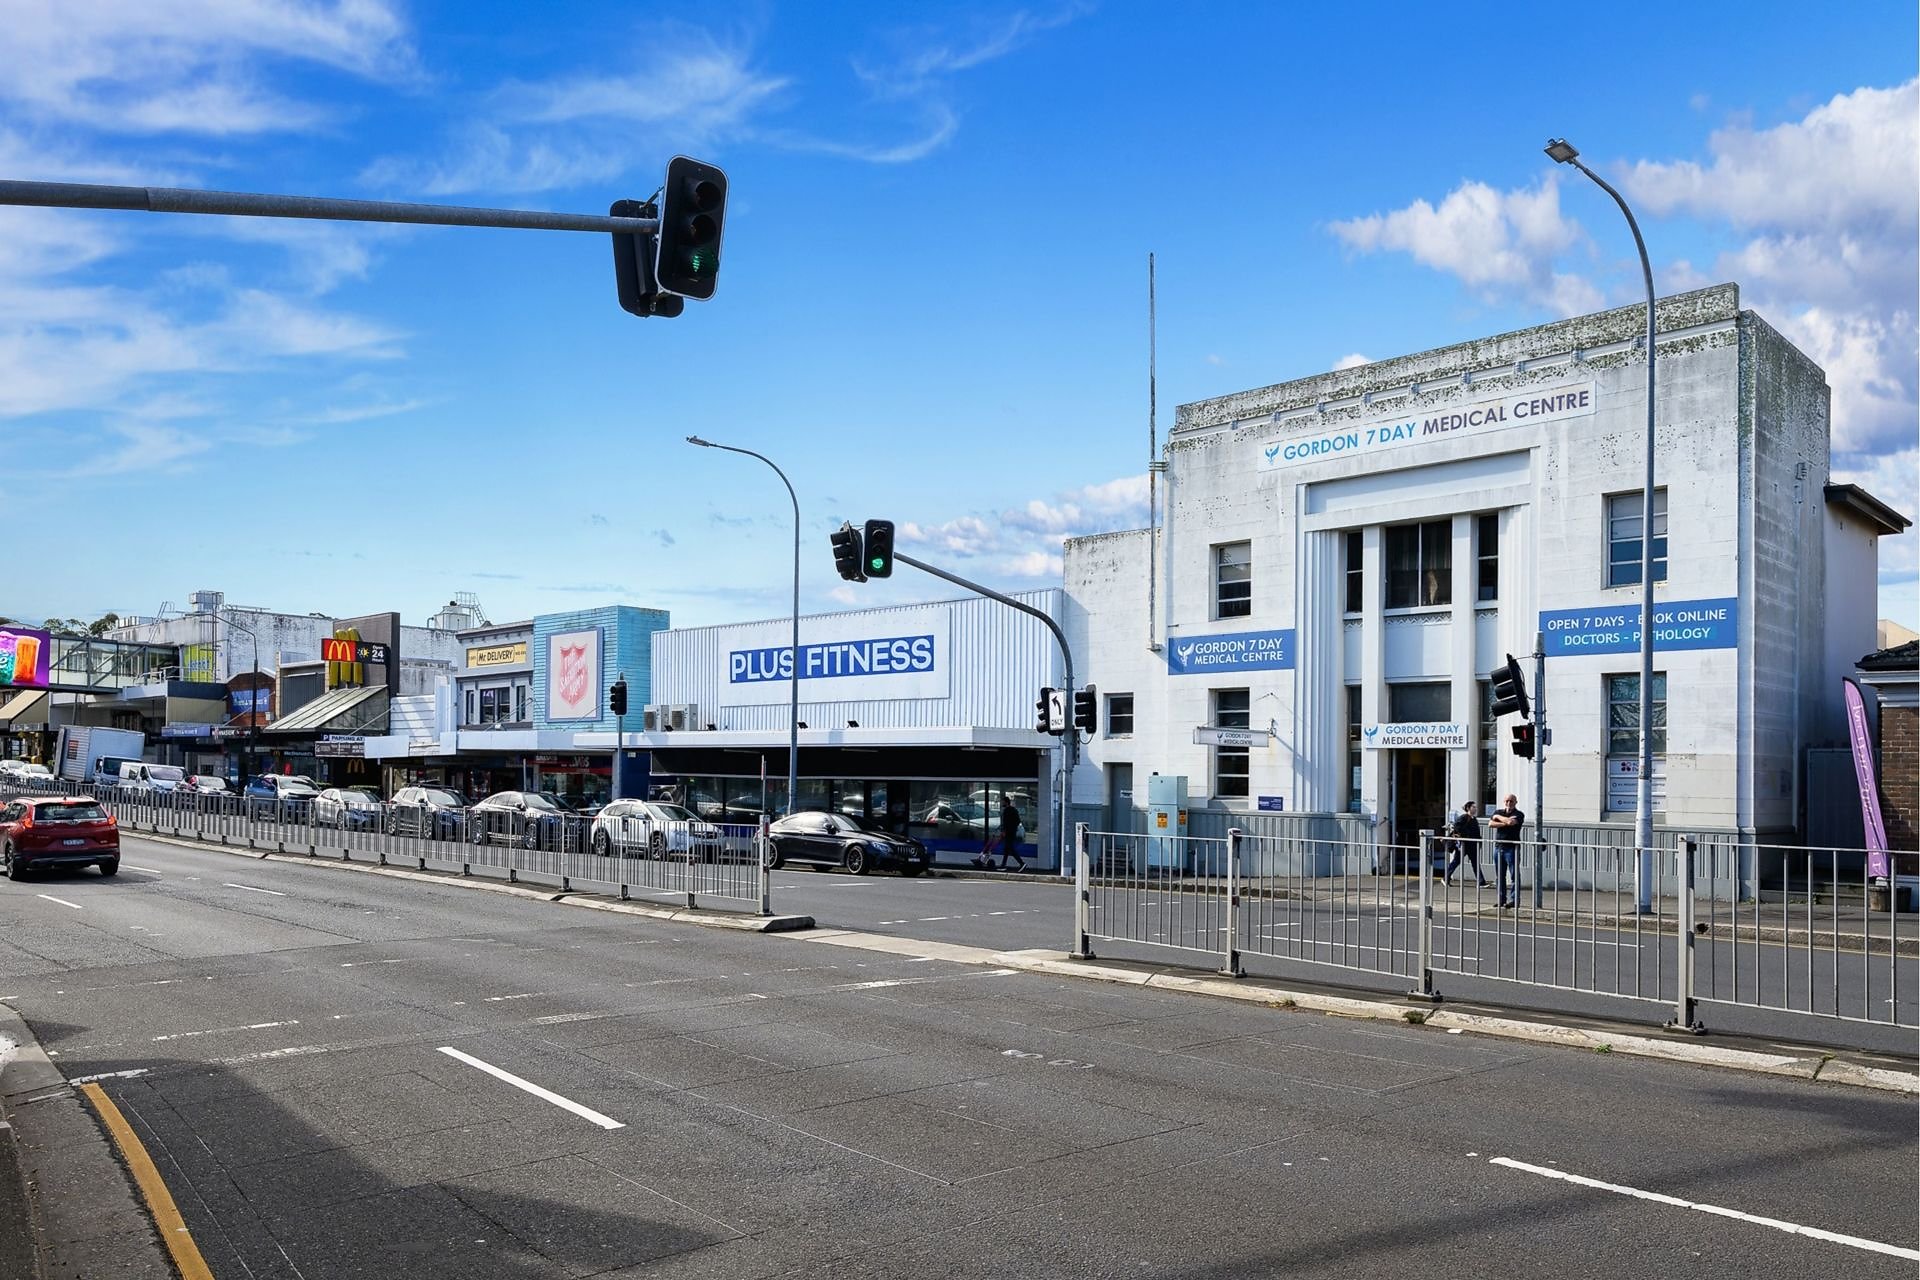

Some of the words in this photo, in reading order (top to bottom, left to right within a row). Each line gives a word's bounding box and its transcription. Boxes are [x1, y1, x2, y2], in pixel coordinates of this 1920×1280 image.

[1284, 433, 1358, 460] GORDON
[1366, 430, 1376, 445] 7
[1380, 422, 1416, 443] DAY
[1422, 407, 1507, 435] MEDICAL
[1514, 390, 1589, 418] CENTRE
[1547, 618, 1579, 631] OPEN
[1584, 617, 1591, 629] 7
[1594, 615, 1625, 628] DAYS
[1677, 609, 1727, 623] ONLINE
[1195, 640, 1246, 654] GORDON
[1249, 639, 1256, 651] 7
[1258, 637, 1283, 650] DAY
[1564, 632, 1620, 646] DOCTORS
[372, 650, 384, 658] 24
[487, 649, 514, 661] DELIVERY
[731, 648, 793, 681] PLUS
[806, 638, 932, 676] FITNESS
[1194, 653, 1239, 665] MEDICAL
[1241, 650, 1284, 662] CENTRE
[1051, 719, 1063, 727] ONLY
[1386, 725, 1428, 734] GORDON
[1431, 725, 1436, 734] 7
[1439, 724, 1459, 734] DAY
[1382, 736, 1426, 745] MEDICAL
[1427, 735, 1464, 745] CENTRE
